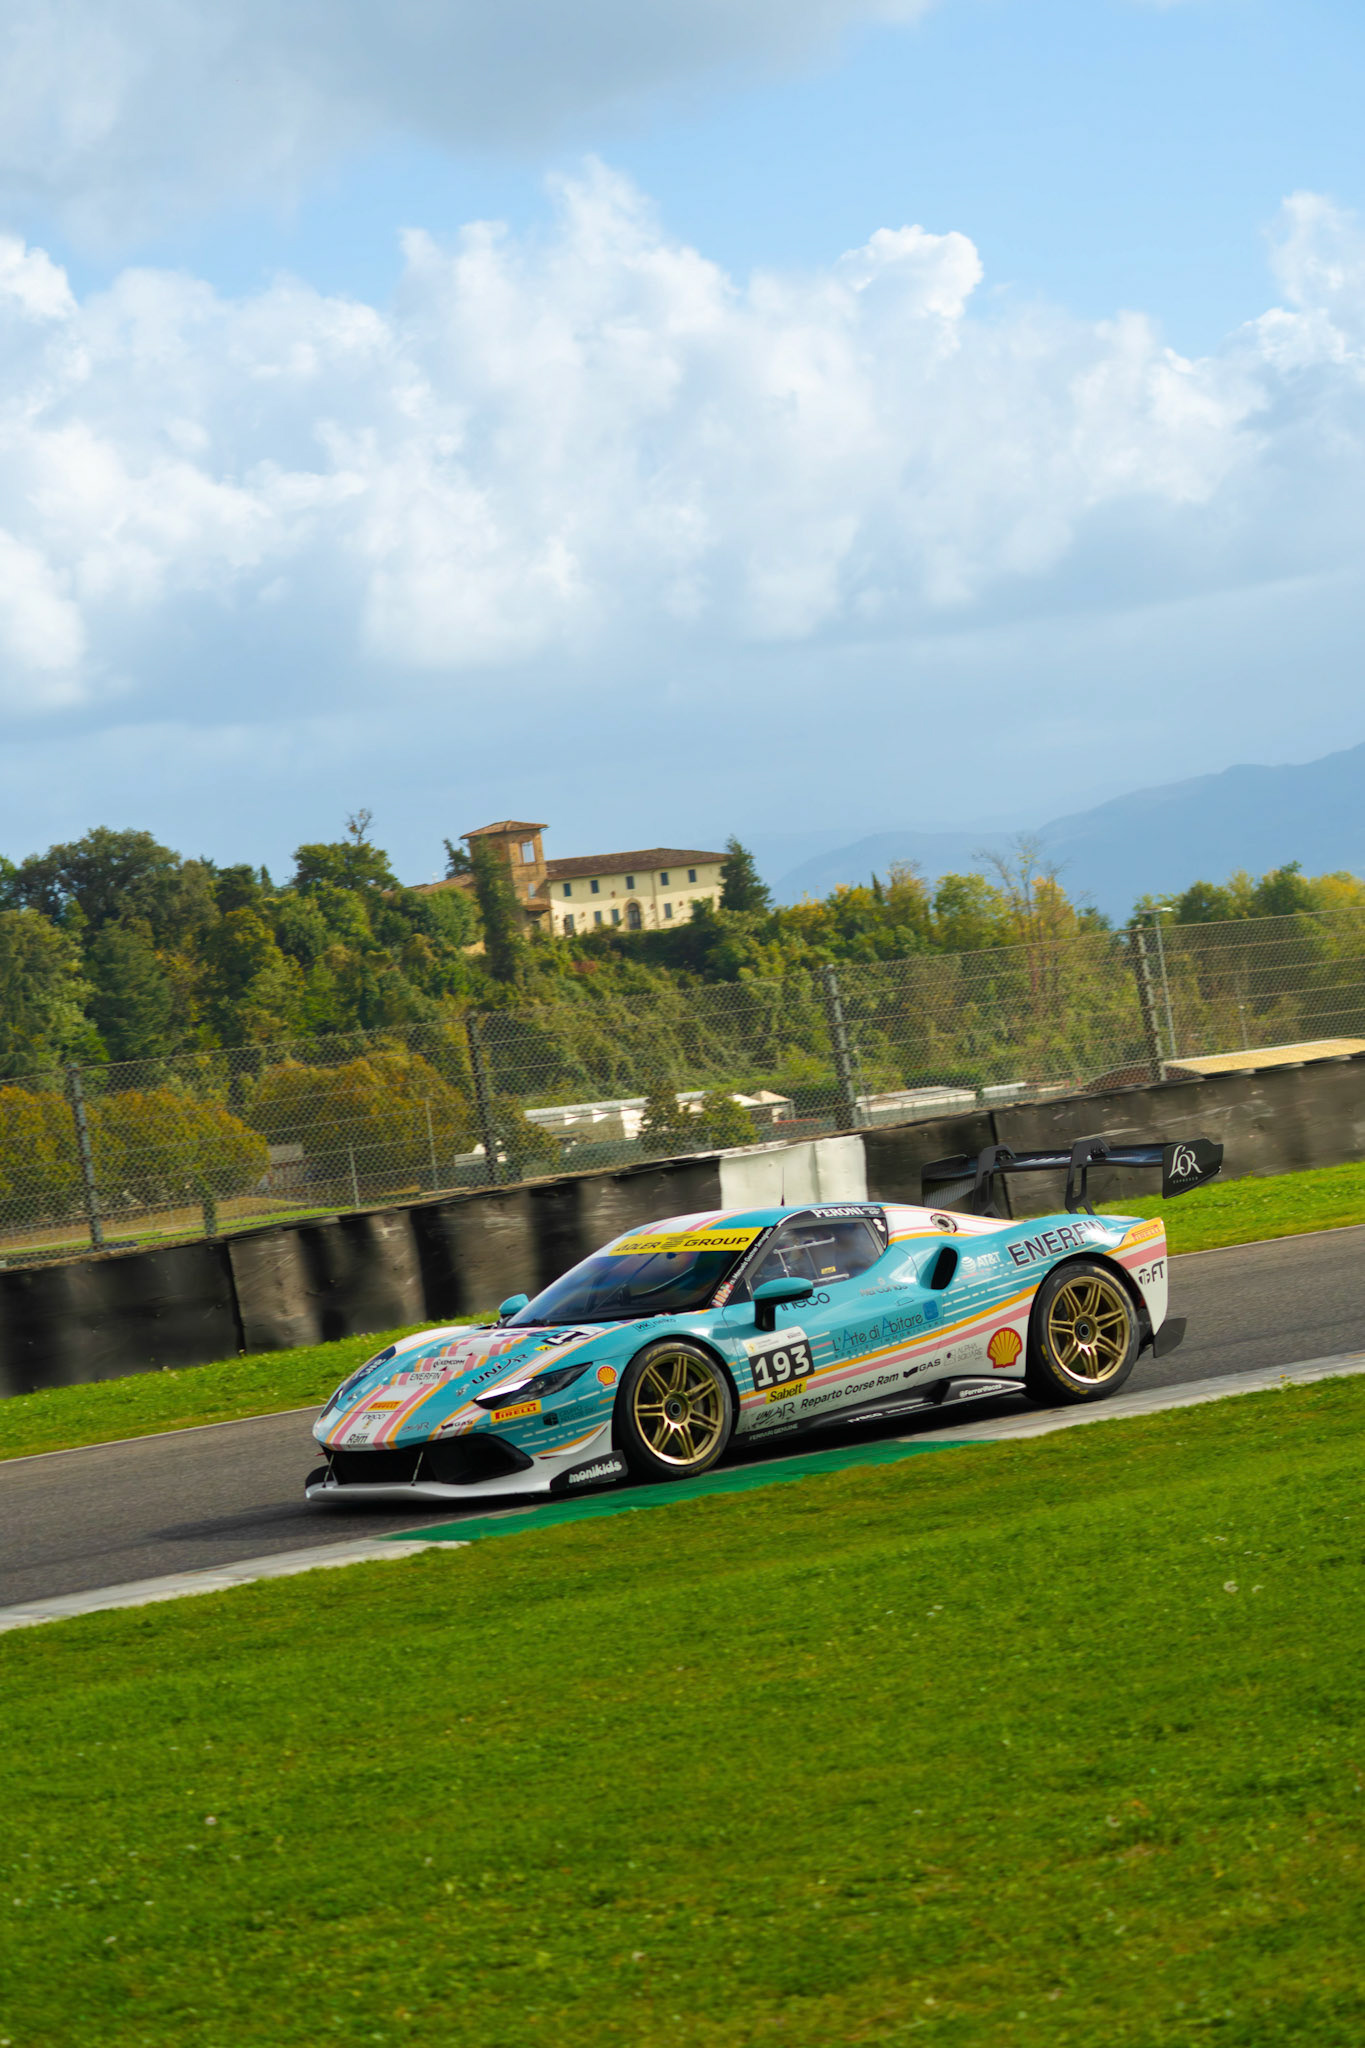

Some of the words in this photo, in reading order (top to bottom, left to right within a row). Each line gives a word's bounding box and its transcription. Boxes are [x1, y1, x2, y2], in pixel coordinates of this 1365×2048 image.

[810, 1206, 865, 1218] PERONI
[616, 1241, 661, 1251] ADLER
[684, 1237, 750, 1247] GROUP
[1007, 1217, 1107, 1267] ENERFIN
[976, 1251, 1001, 1268] AT&T
[869, 1324, 880, 1340] di
[882, 1314, 923, 1338] Abitare
[754, 1344, 810, 1387] 193
[919, 1358, 941, 1371] GAS
[770, 1383, 803, 1402] Sabelt
[800, 1390, 843, 1410] Reparto
[845, 1377, 875, 1395] Corse
[876, 1373, 899, 1385] Ram
[495, 1403, 537, 1419] PIRELLI
